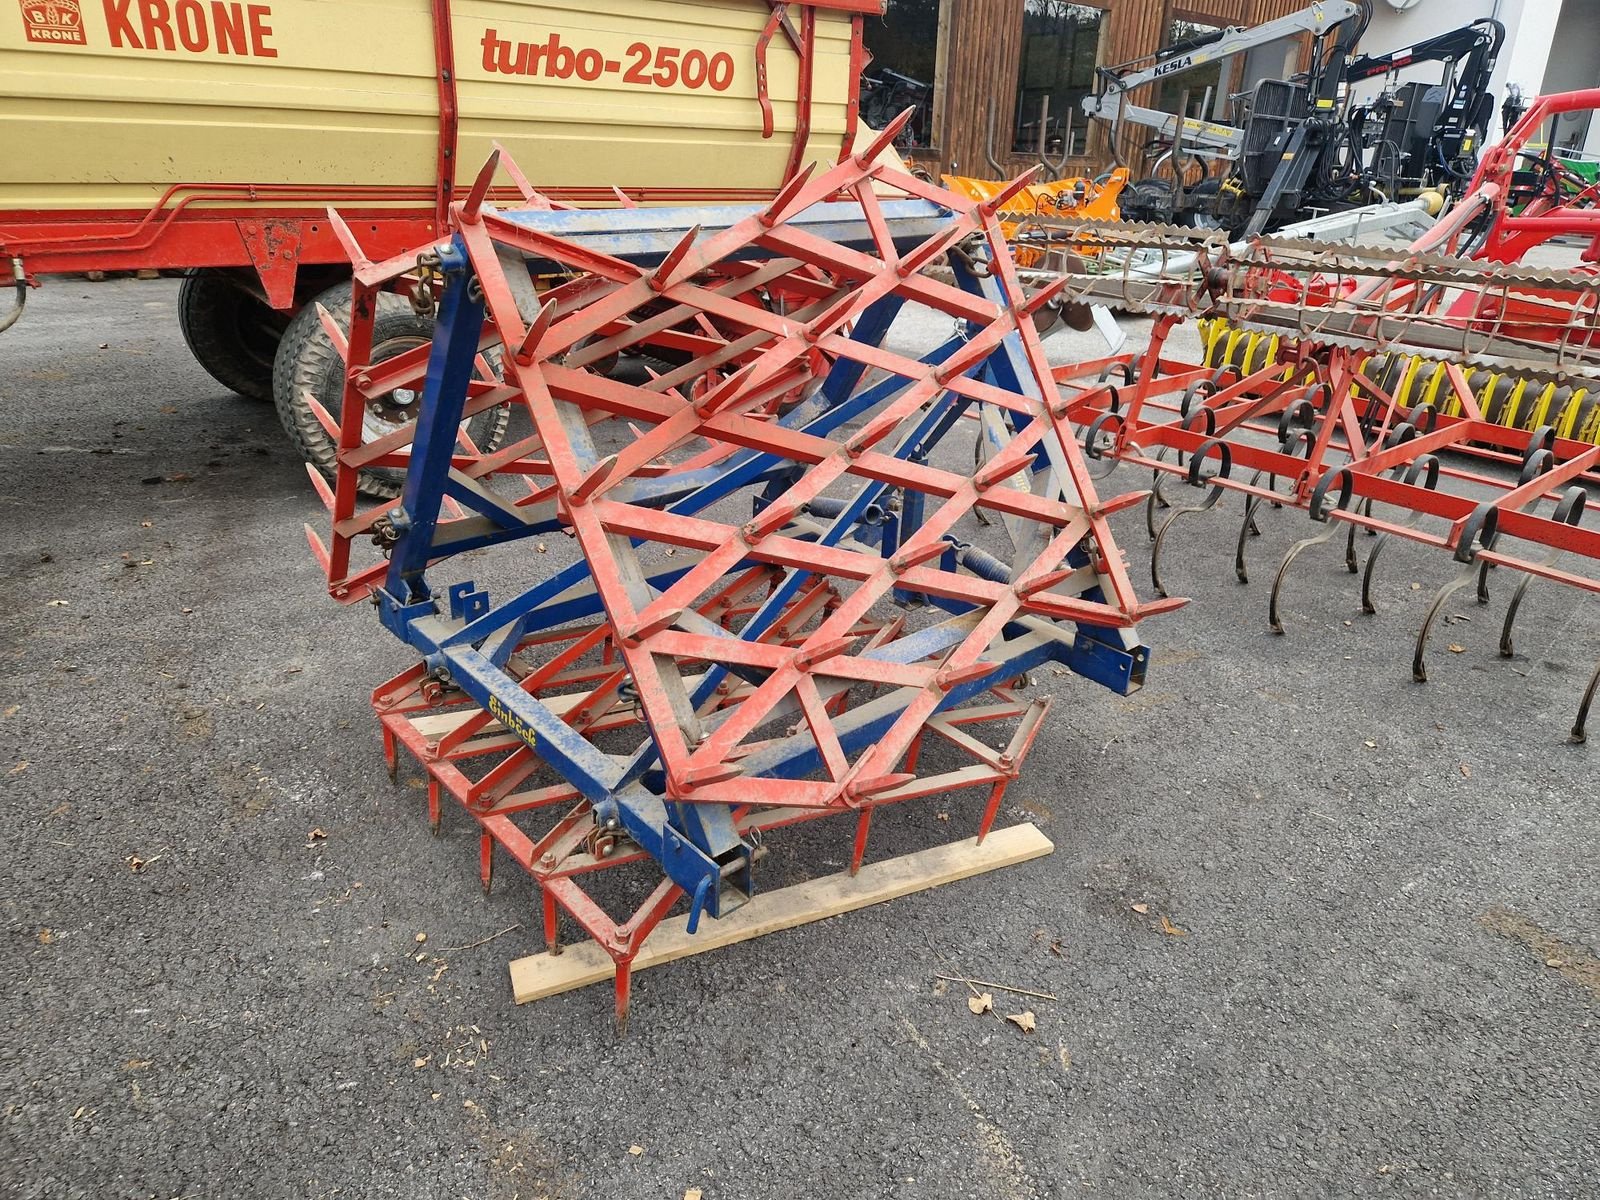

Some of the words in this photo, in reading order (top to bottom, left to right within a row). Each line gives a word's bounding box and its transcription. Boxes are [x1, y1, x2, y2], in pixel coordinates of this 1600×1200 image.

[30, 28, 81, 41] KRONE
[31, 10, 46, 23] B
[61, 13, 73, 25] K
[102, 0, 278, 58] KRONE
[481, 28, 735, 92] turbo-2500
[1153, 56, 1192, 77] KESLA
[488, 694, 536, 747] Einböck
